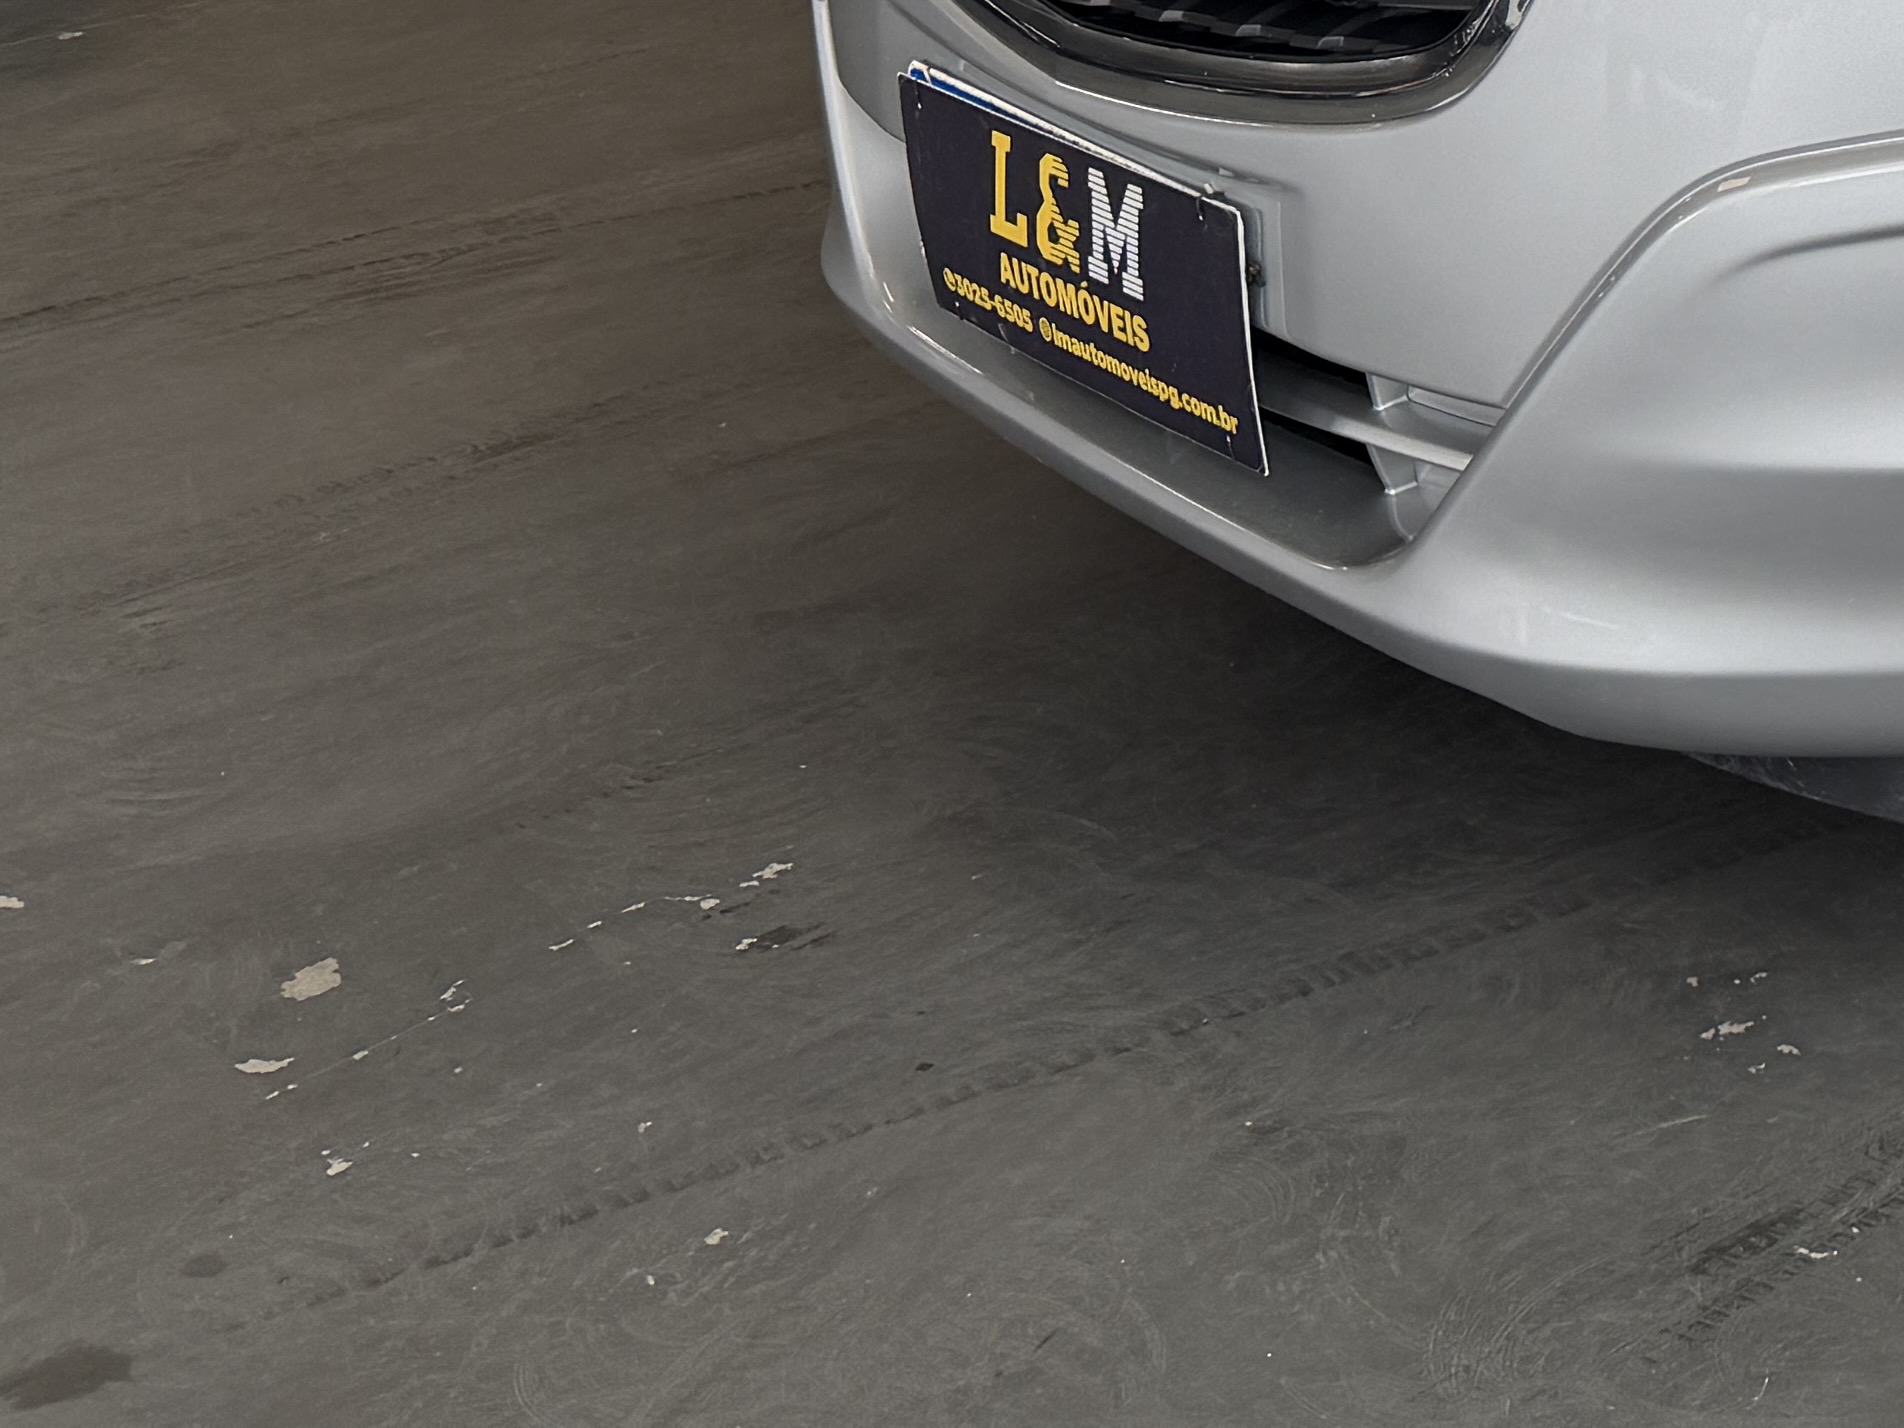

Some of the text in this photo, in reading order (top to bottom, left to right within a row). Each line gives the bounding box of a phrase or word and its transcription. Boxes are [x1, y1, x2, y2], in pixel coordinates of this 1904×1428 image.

[990, 130, 1144, 301] L&M
[953, 272, 1034, 332] 3025-6505
[1000, 251, 1151, 352] AUTOMÓVEIS
